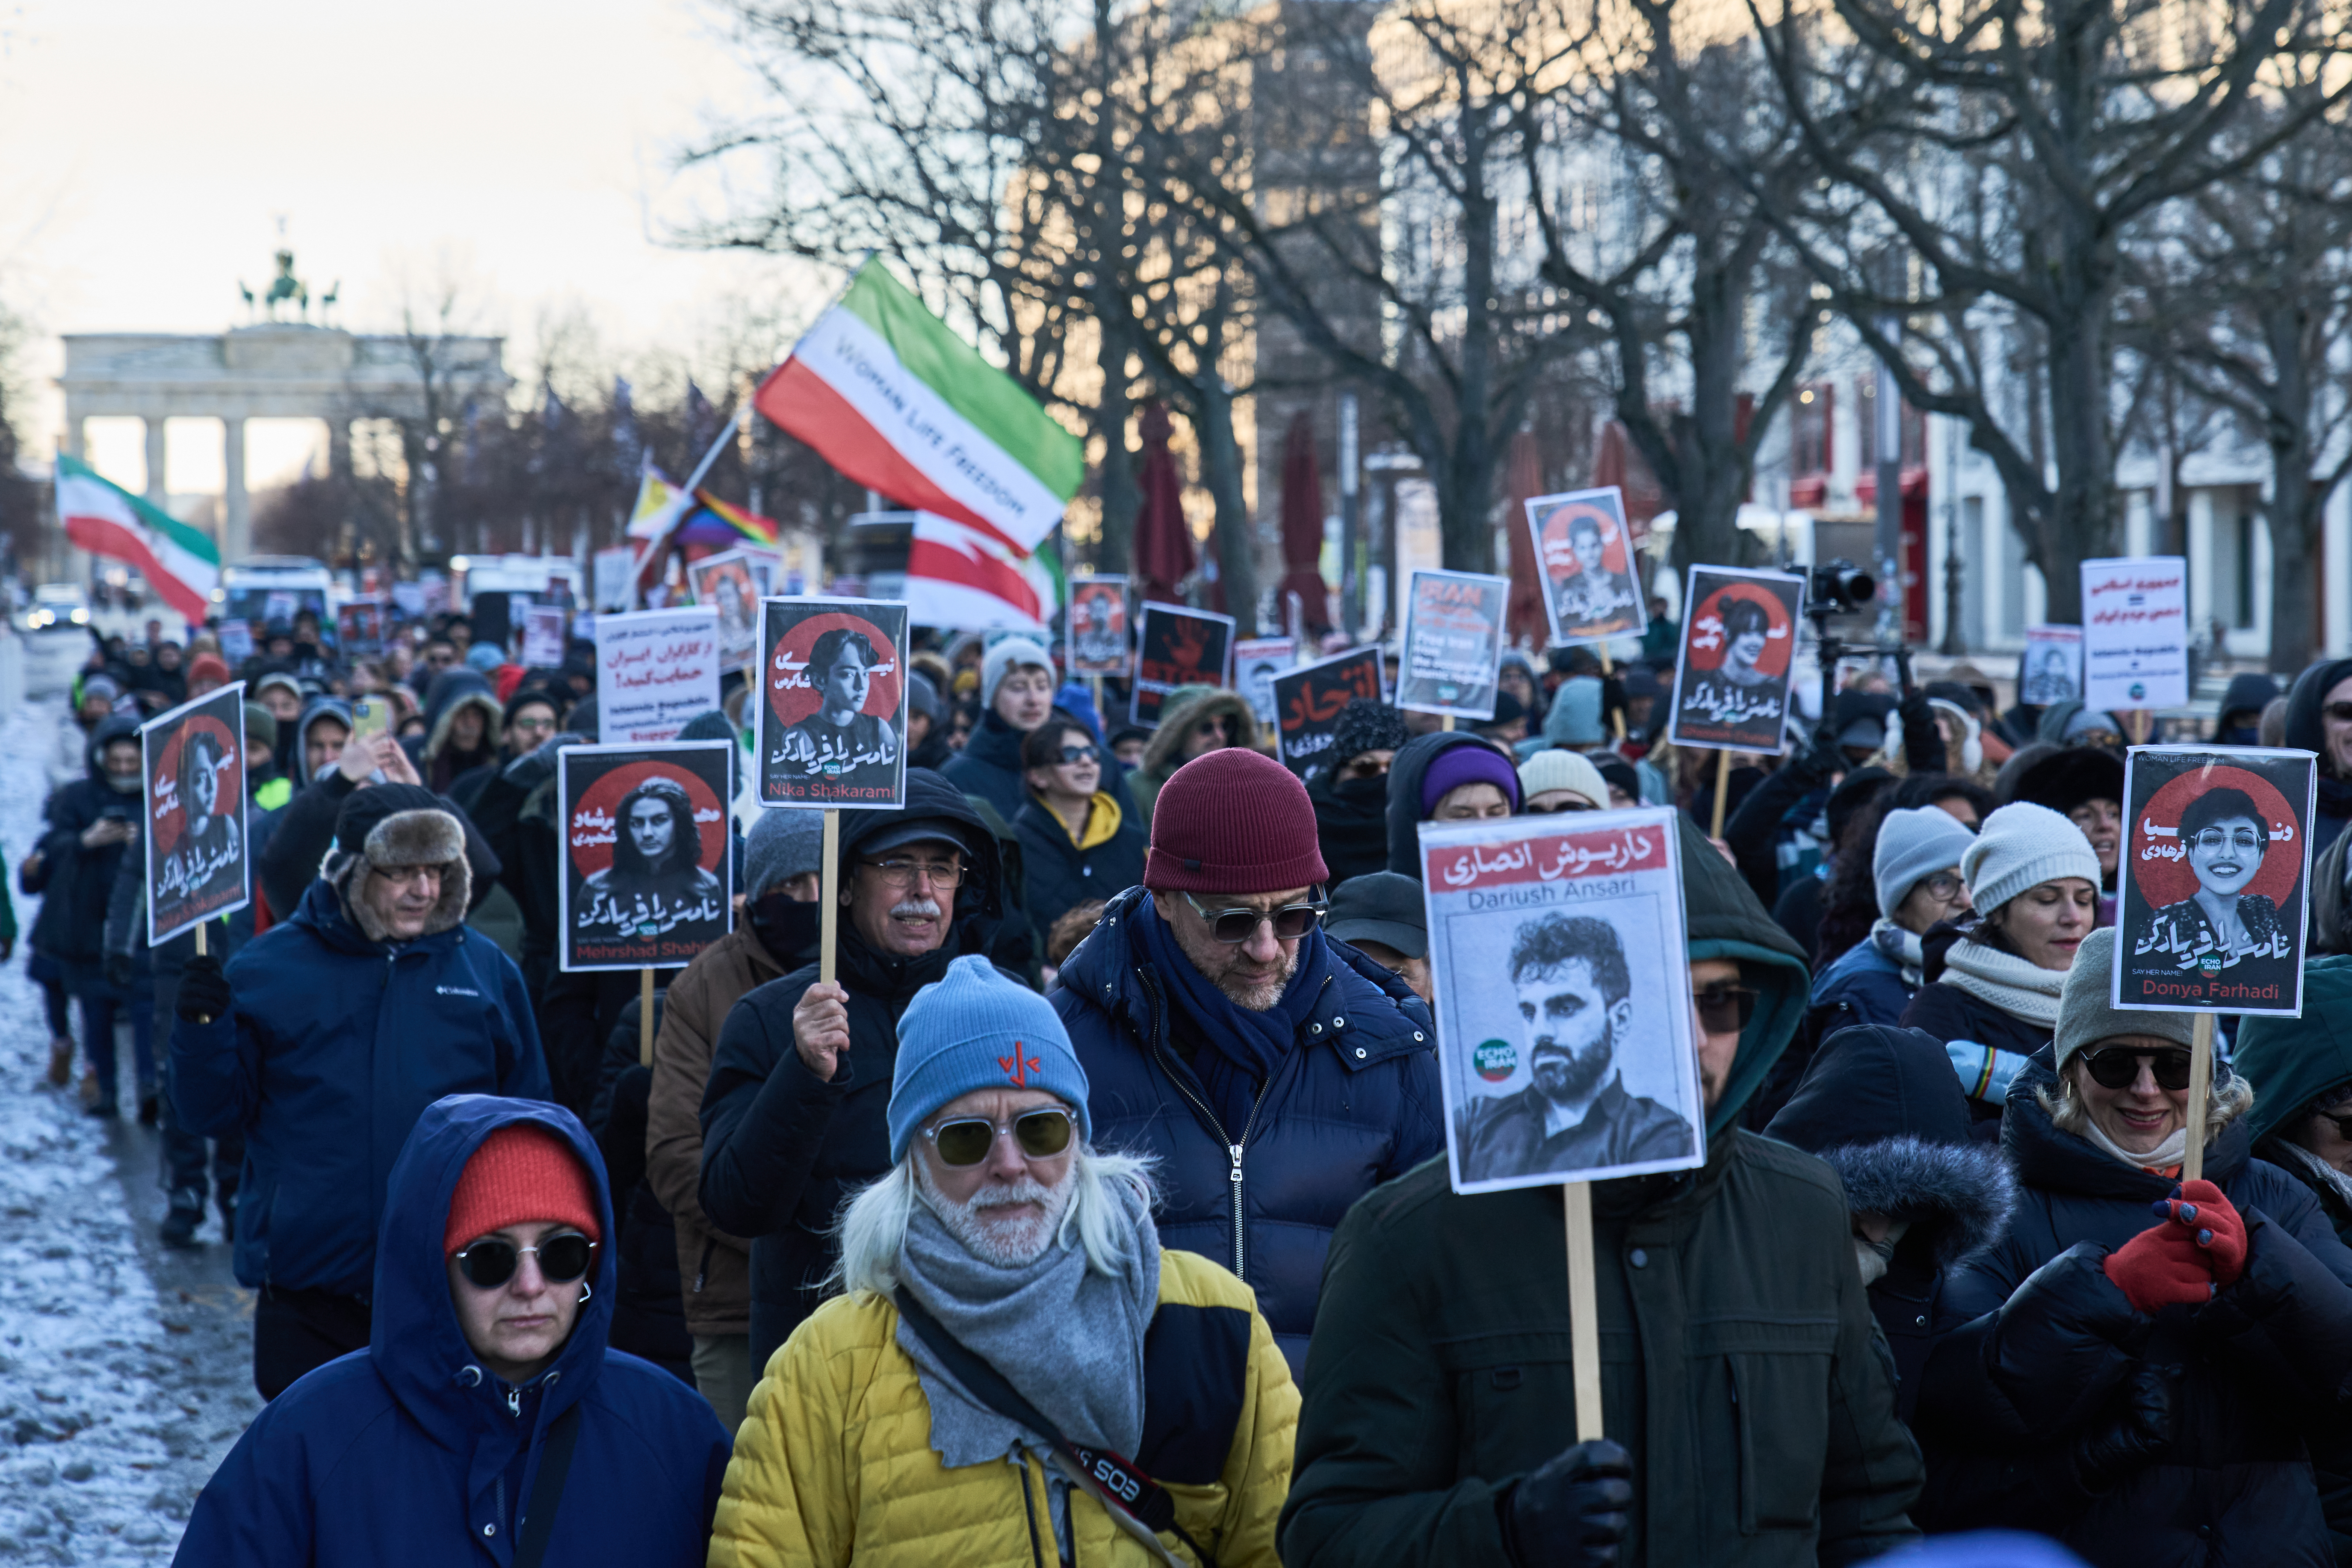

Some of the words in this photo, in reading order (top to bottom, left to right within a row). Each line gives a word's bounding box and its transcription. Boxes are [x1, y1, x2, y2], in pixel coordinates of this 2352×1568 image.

[835, 334, 904, 413] WOMAN
[905, 408, 943, 448] LIFE
[945, 444, 1025, 518] FREEDOM
[1420, 581, 1482, 605] IRAN
[770, 783, 805, 796] Nika
[810, 783, 895, 798] Shakarami
[1539, 831, 1652, 880] داریوش
[2142, 839, 2187, 862] فرهادی
[1443, 841, 1533, 886] انصاری
[1467, 883, 1556, 910] Dariush
[1563, 874, 1635, 900] Ansari
[577, 943, 657, 959] Mehrshad
[2143, 980, 2201, 998] Donya
[2209, 983, 2278, 999] Farhadi
[1477, 1046, 1514, 1060] ECHO
[1485, 1057, 1516, 1069] IRAN
[1093, 1458, 1140, 1502] EOS
